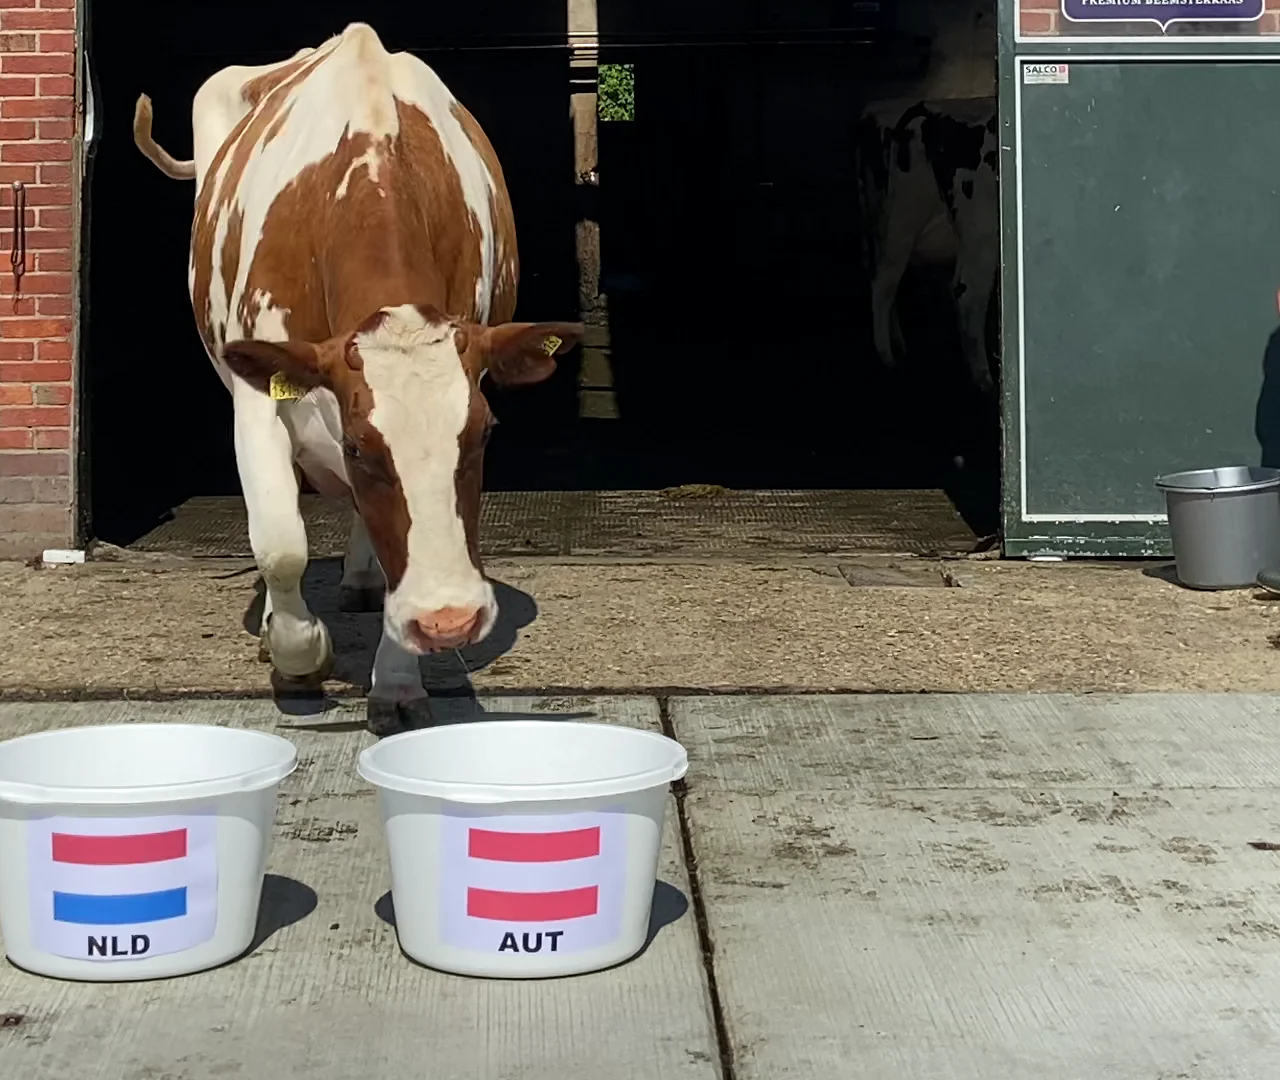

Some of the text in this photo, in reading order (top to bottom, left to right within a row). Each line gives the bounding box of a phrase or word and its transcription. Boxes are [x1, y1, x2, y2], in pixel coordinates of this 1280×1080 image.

[1025, 65, 1057, 73] SALCO
[87, 934, 150, 956] NLD
[498, 931, 564, 953] AUT
